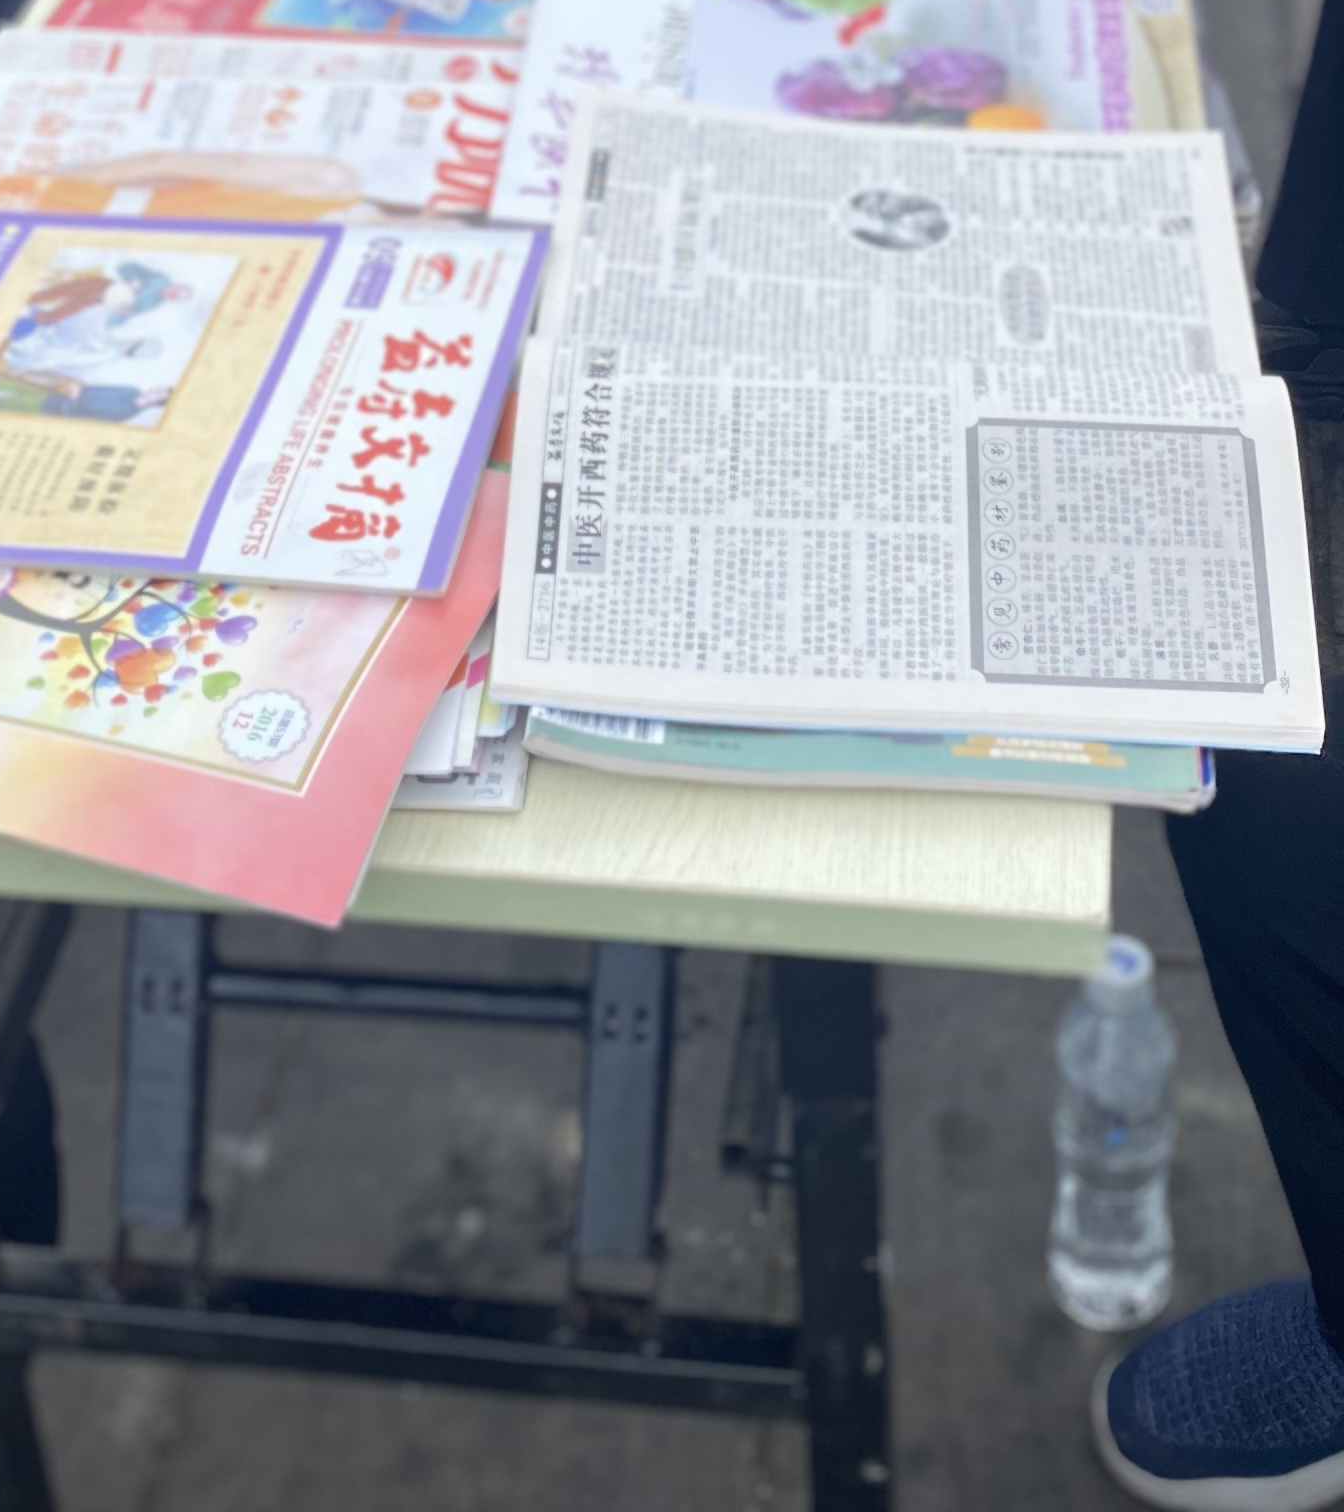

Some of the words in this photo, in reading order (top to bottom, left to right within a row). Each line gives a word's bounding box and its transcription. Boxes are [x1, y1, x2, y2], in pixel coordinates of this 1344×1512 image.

[283, 418, 310, 452] LIFE
[306, 329, 475, 545] 益寿文摘
[239, 452, 294, 559] ABSTRACTS
[541, 501, 558, 555] 中医中药
[990, 442, 1015, 654] 常见中药材鉴别
[232, 711, 254, 729] 12
[247, 706, 278, 743] 2016
